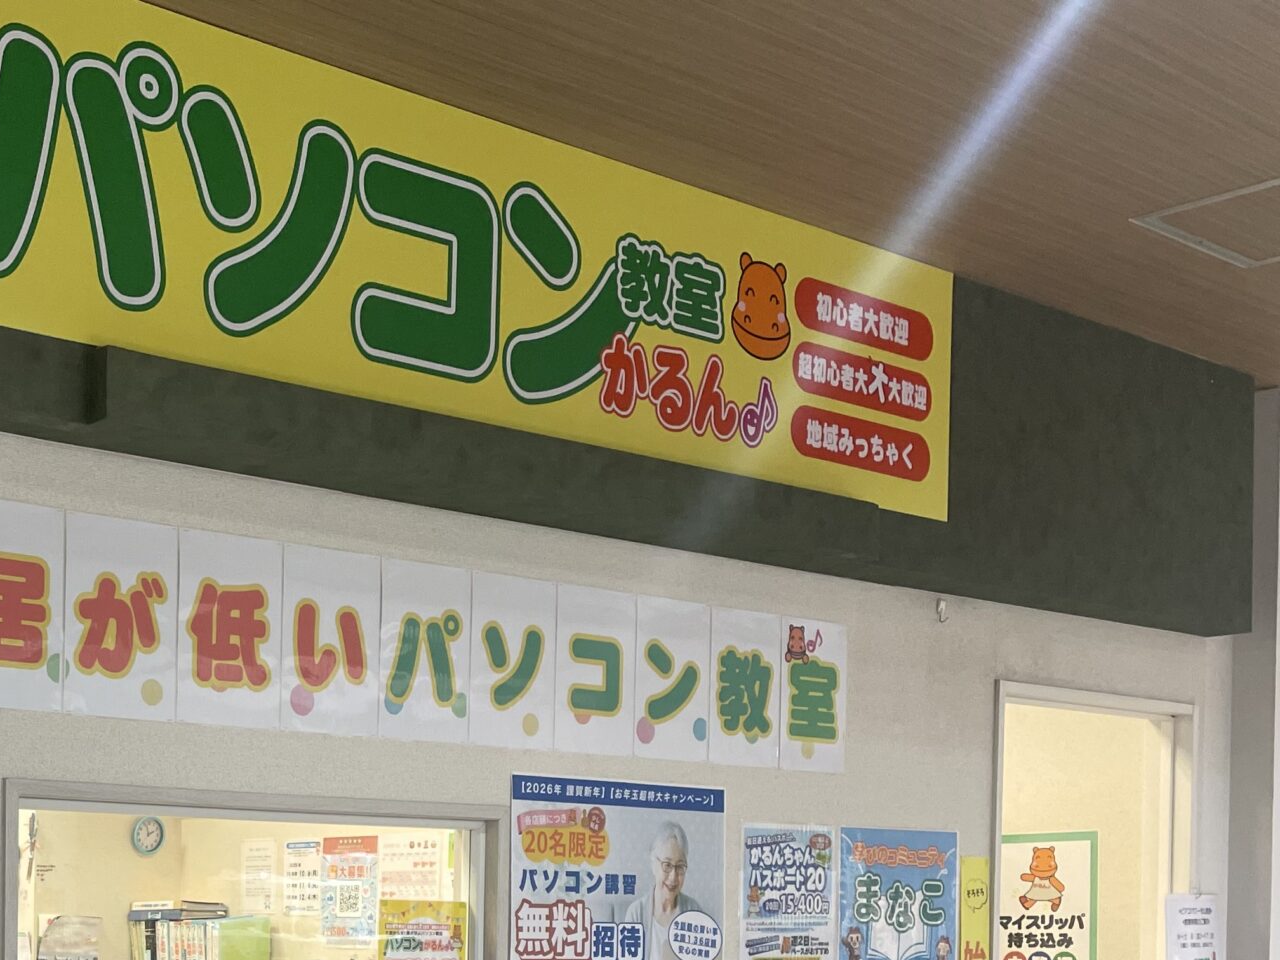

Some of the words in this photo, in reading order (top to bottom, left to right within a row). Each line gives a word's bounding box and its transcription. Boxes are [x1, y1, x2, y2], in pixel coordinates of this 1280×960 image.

[617, 233, 725, 344] 教室
[817, 292, 909, 346] 初心者大歓迎
[799, 352, 926, 410] 超初心者大大大歓迎
[807, 419, 912, 469] 地域みっちゃく
[525, 830, 607, 859] 20名限定
[519, 869, 637, 895] パソコン講習
[854, 872, 946, 933] まなこ
[516, 899, 591, 958] 無料
[593, 923, 643, 959] 招待
[1000, 913, 1086, 930] マイスリッパ
[1008, 933, 1074, 949] 持ち込み
